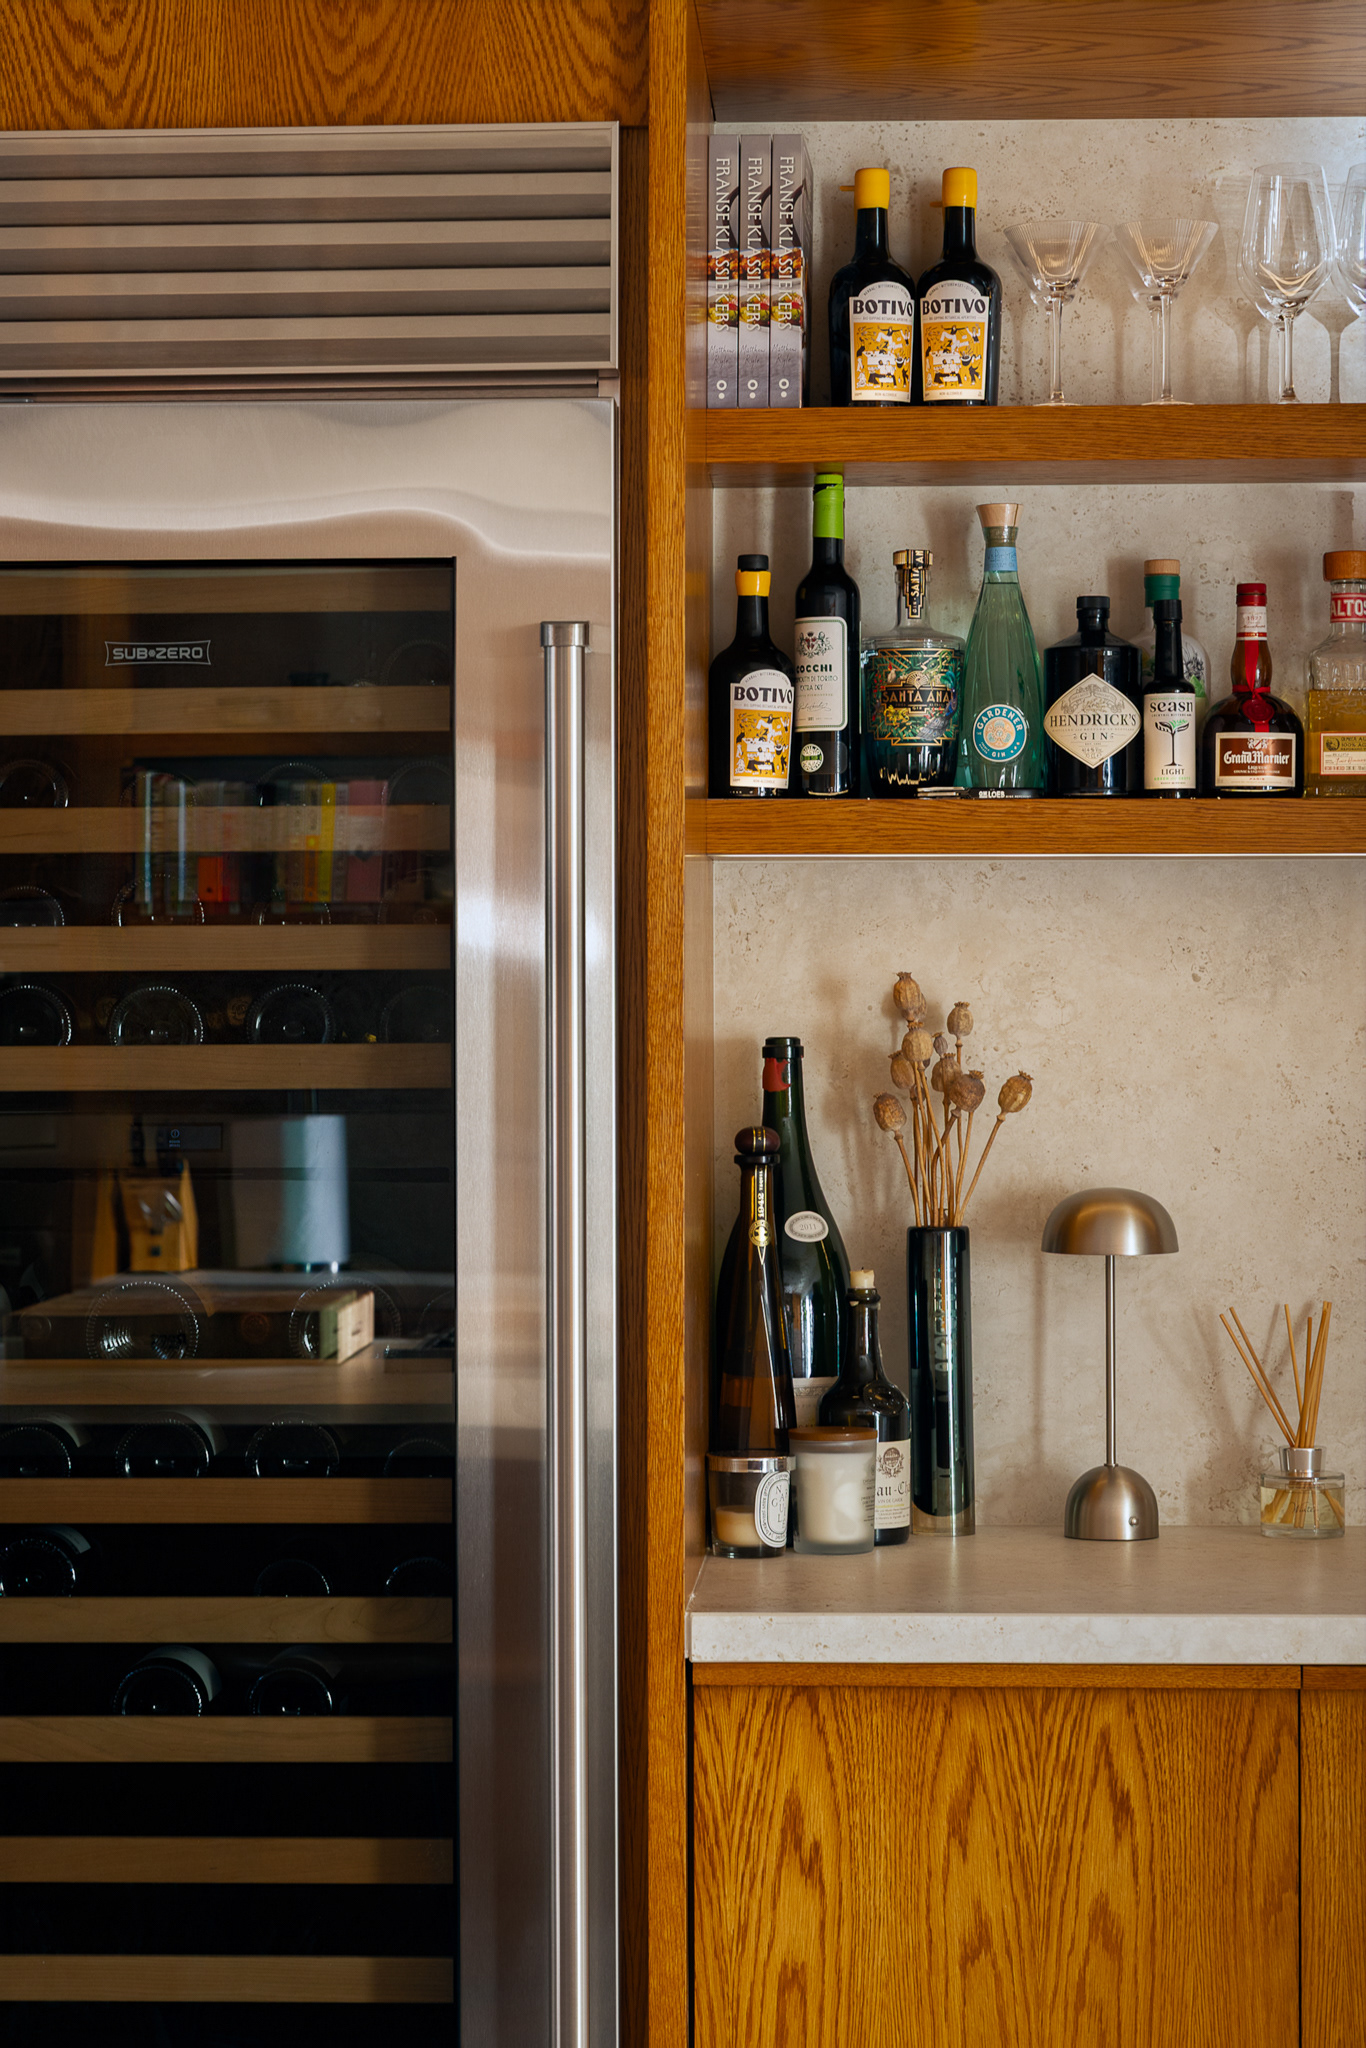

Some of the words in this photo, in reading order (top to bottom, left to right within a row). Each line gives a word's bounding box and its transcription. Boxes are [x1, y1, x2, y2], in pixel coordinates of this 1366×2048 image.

[716, 158, 730, 220] FRANSE
[748, 158, 762, 220] FRANSE
[780, 156, 794, 219] FRANSE
[716, 225, 730, 331] KLASSIEKERS
[747, 225, 762, 331] KLASSIEKERS
[778, 224, 793, 330] KLASSIEKERS
[853, 300, 913, 316] BOTIVO
[923, 298, 986, 315] BOTIVO
[915, 550, 924, 564] AN
[734, 686, 792, 704] BOTIVO
[883, 690, 922, 702] SANTA
[927, 690, 949, 702] ANA
[1150, 701, 1193, 712] seasn
[977, 708, 1023, 731] GARDENER
[1050, 714, 1136, 727] HENDRICK'S
[1224, 751, 1252, 764] Grand
[1252, 751, 1290, 764] Marnier
